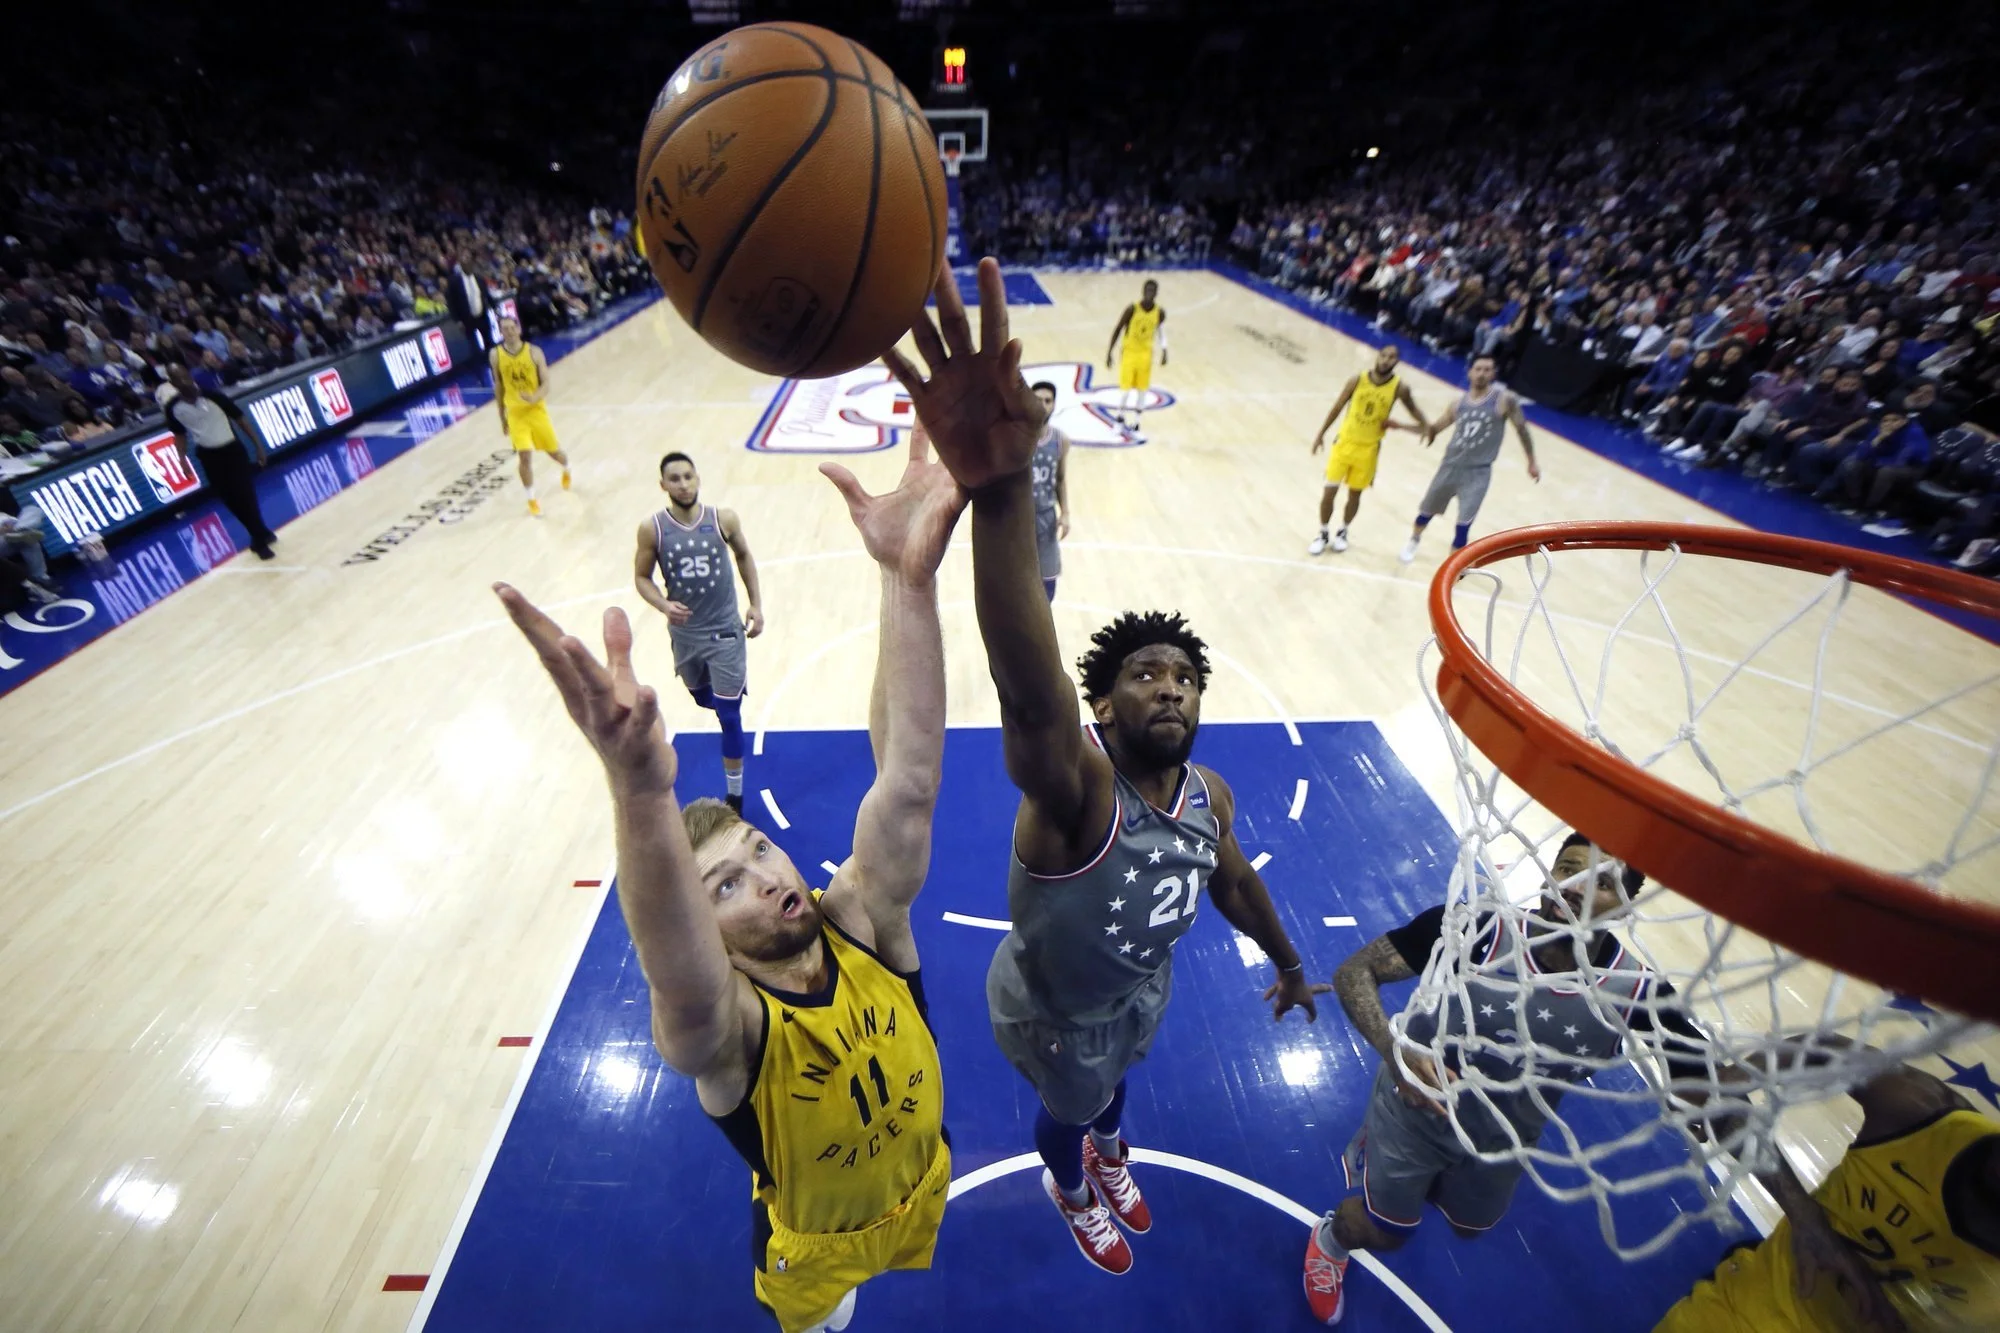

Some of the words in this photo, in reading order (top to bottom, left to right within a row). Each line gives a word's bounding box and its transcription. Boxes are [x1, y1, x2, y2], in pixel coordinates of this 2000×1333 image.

[382, 339, 428, 391] WATCH
[248, 385, 317, 450] WATCH
[1463, 421, 1481, 438] 17
[30, 459, 143, 545] WATCH
[680, 555, 711, 578] 25
[1149, 868, 1199, 928] 21
[791, 1005, 897, 1102] INDINA
[816, 1069, 923, 1168] PACERS
[850, 1054, 890, 1129] 11
